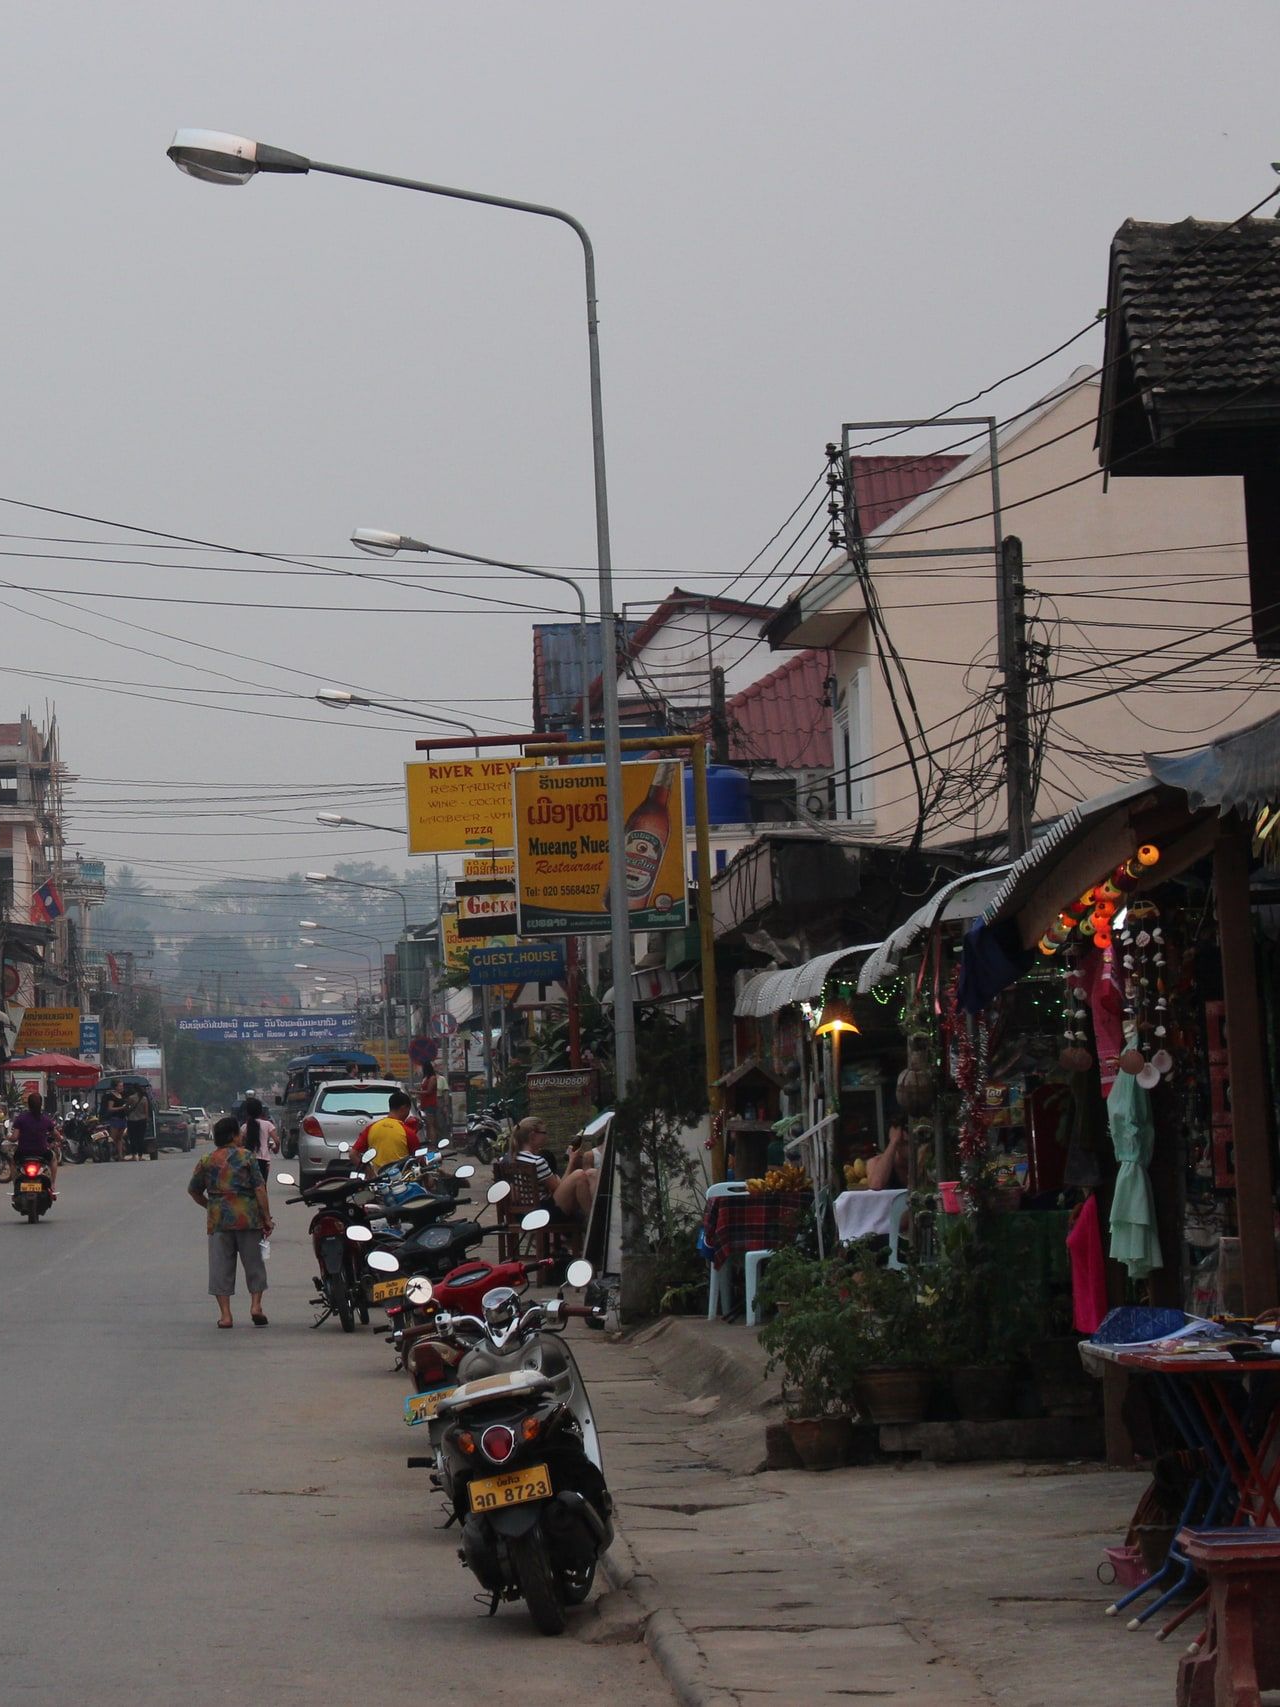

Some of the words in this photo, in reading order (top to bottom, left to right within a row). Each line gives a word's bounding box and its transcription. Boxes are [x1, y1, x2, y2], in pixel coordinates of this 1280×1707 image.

[428, 765, 473, 779] RIVER
[428, 800, 457, 808] WINE
[465, 826, 493, 835] PIZZA
[528, 837, 577, 859] Mueang
[535, 860, 604, 875] Restaurant
[525, 886, 541, 897] Tel:
[543, 885, 558, 896] 020
[560, 884, 600, 896] 55684257
[504, 1481, 548, 1503] 8723
